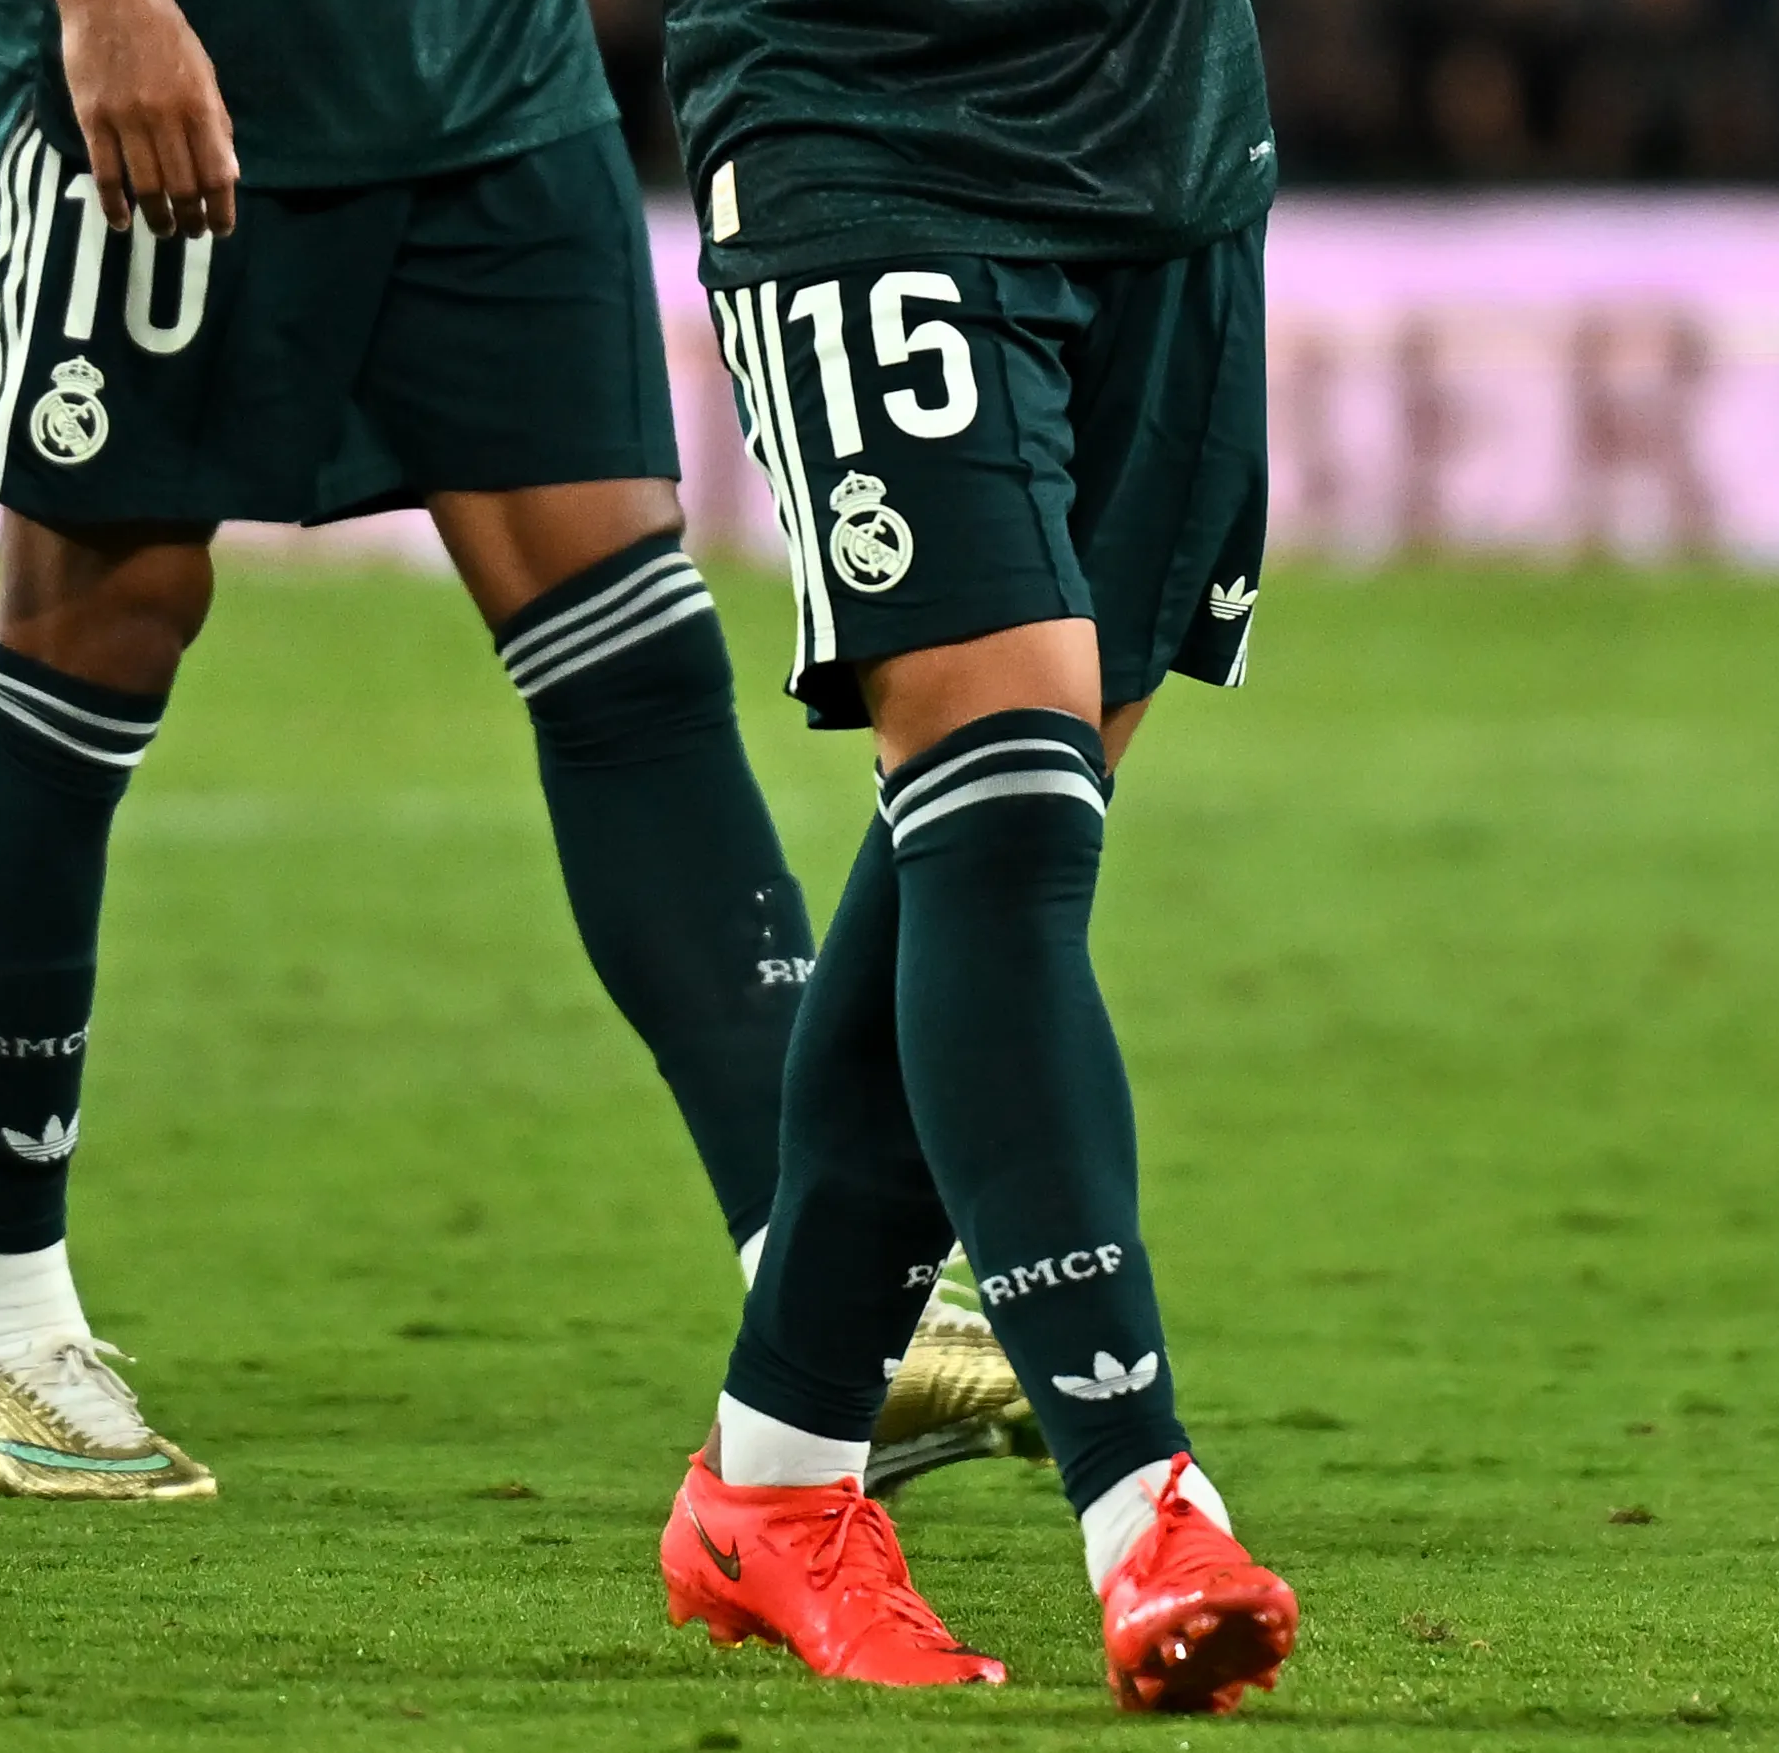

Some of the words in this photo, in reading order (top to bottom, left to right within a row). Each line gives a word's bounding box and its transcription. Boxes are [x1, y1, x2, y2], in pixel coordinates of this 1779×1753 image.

[64, 172, 213, 354] 10
[788, 271, 978, 459] 15
[979, 1242, 1123, 1306] RMCF
